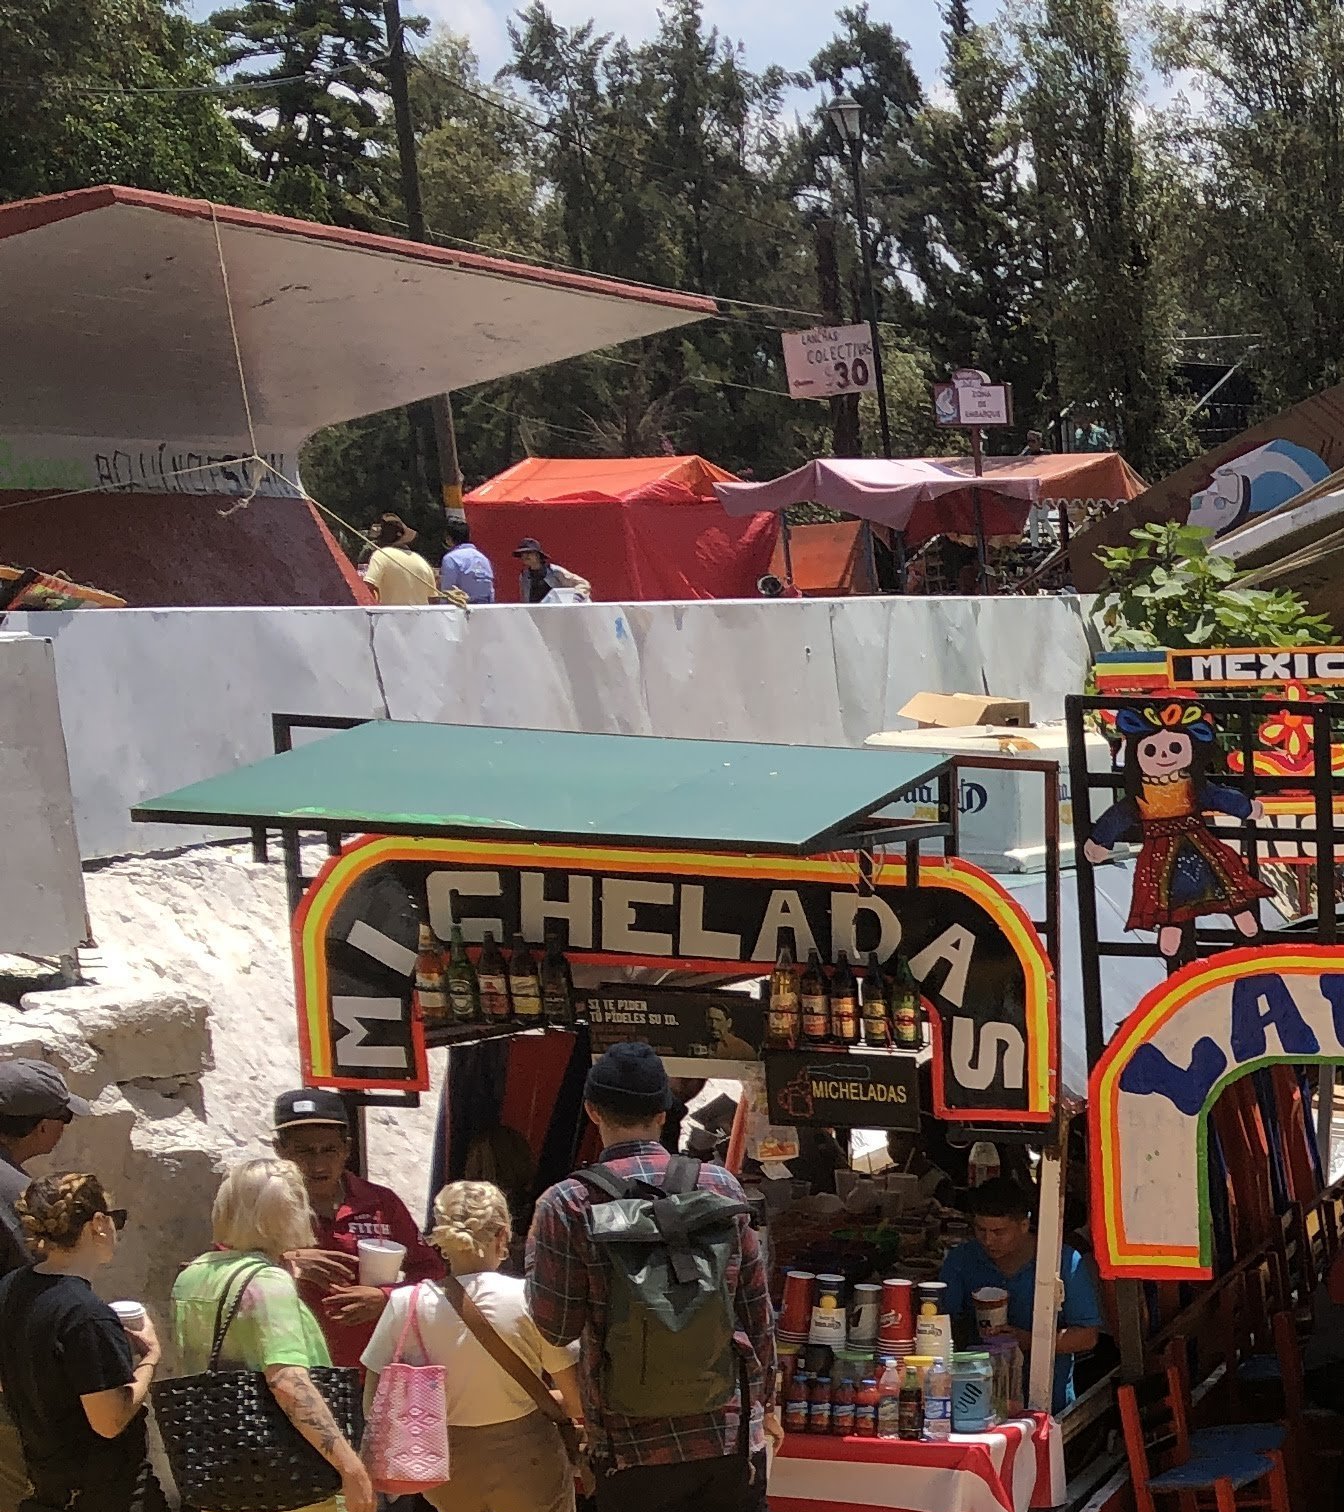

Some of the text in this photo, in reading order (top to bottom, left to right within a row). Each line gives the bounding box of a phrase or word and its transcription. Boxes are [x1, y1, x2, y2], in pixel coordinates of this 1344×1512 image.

[330, 871, 1025, 1091] MICHELADAS
[603, 1000, 615, 1011] TE
[617, 1000, 648, 1012] PIDEN
[812, 1080, 907, 1103] MICHELADAS
[349, 1222, 392, 1235] FITCH
